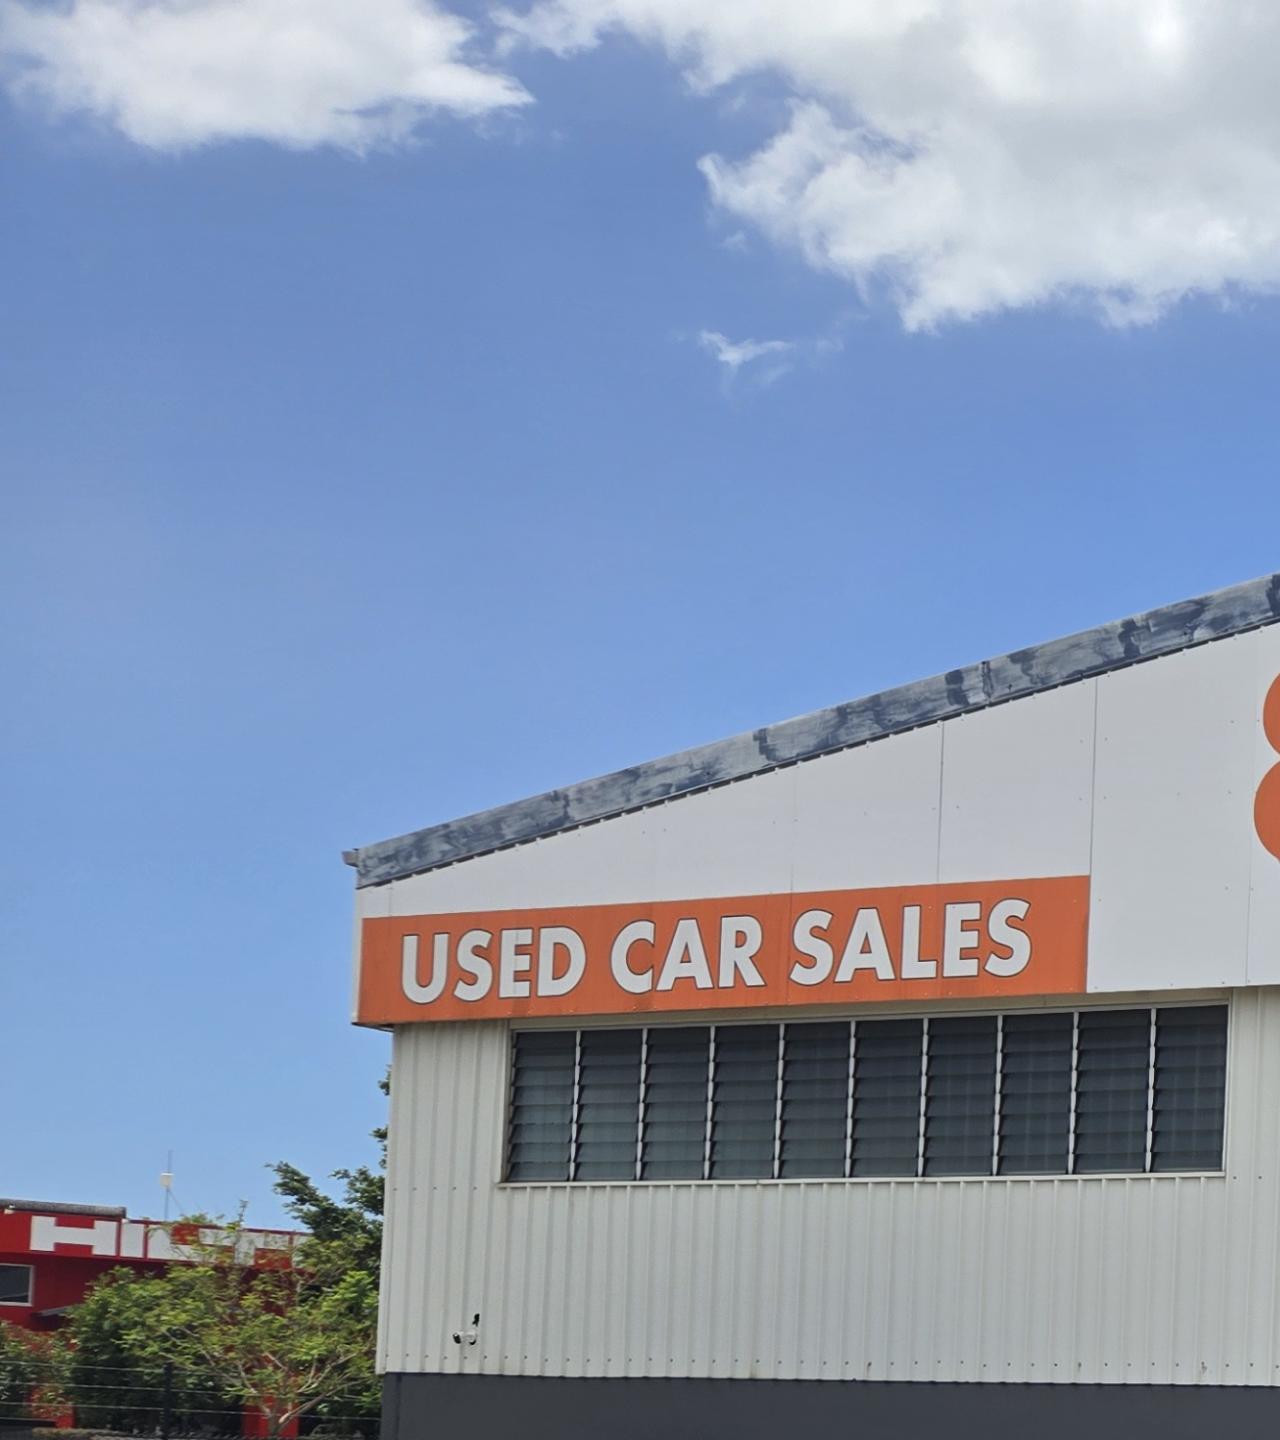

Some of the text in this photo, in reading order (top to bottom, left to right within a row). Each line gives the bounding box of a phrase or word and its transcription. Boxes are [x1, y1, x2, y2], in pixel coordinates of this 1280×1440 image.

[401, 897, 1033, 1005] USED CAR SALES
